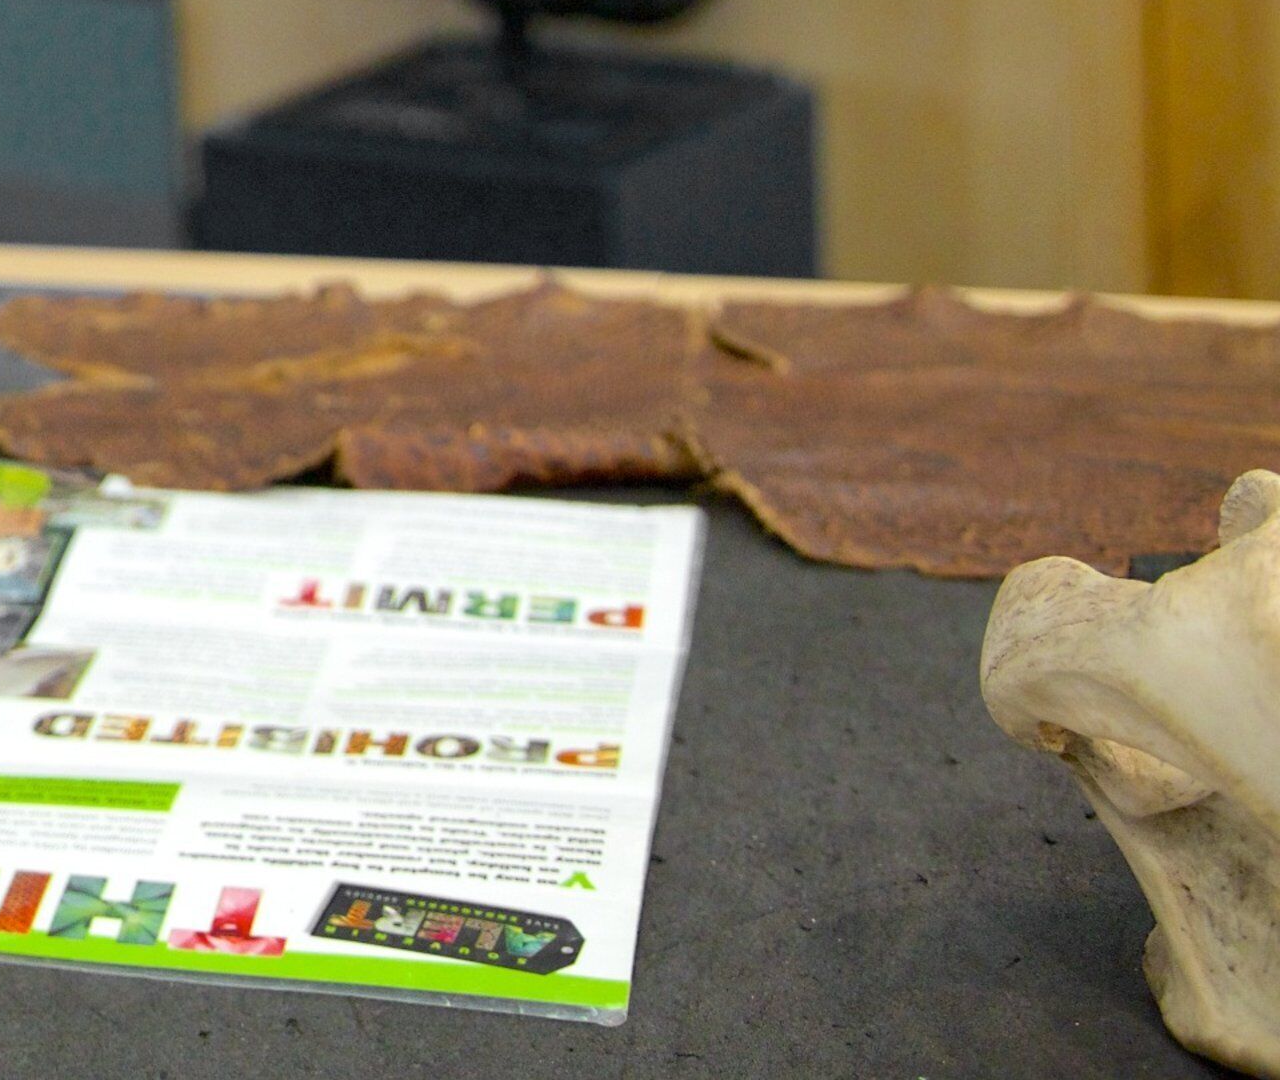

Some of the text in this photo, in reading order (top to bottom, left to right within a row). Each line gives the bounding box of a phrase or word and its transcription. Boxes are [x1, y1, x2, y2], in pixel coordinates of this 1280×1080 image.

[275, 578, 645, 629] PERMIT
[31, 711, 621, 769] PROHIBITED
[328, 898, 557, 958] ALERT
[406, 897, 518, 923] ENDANGERED
[525, 918, 560, 931] SAVE
[323, 924, 528, 965] SOUVENIR
